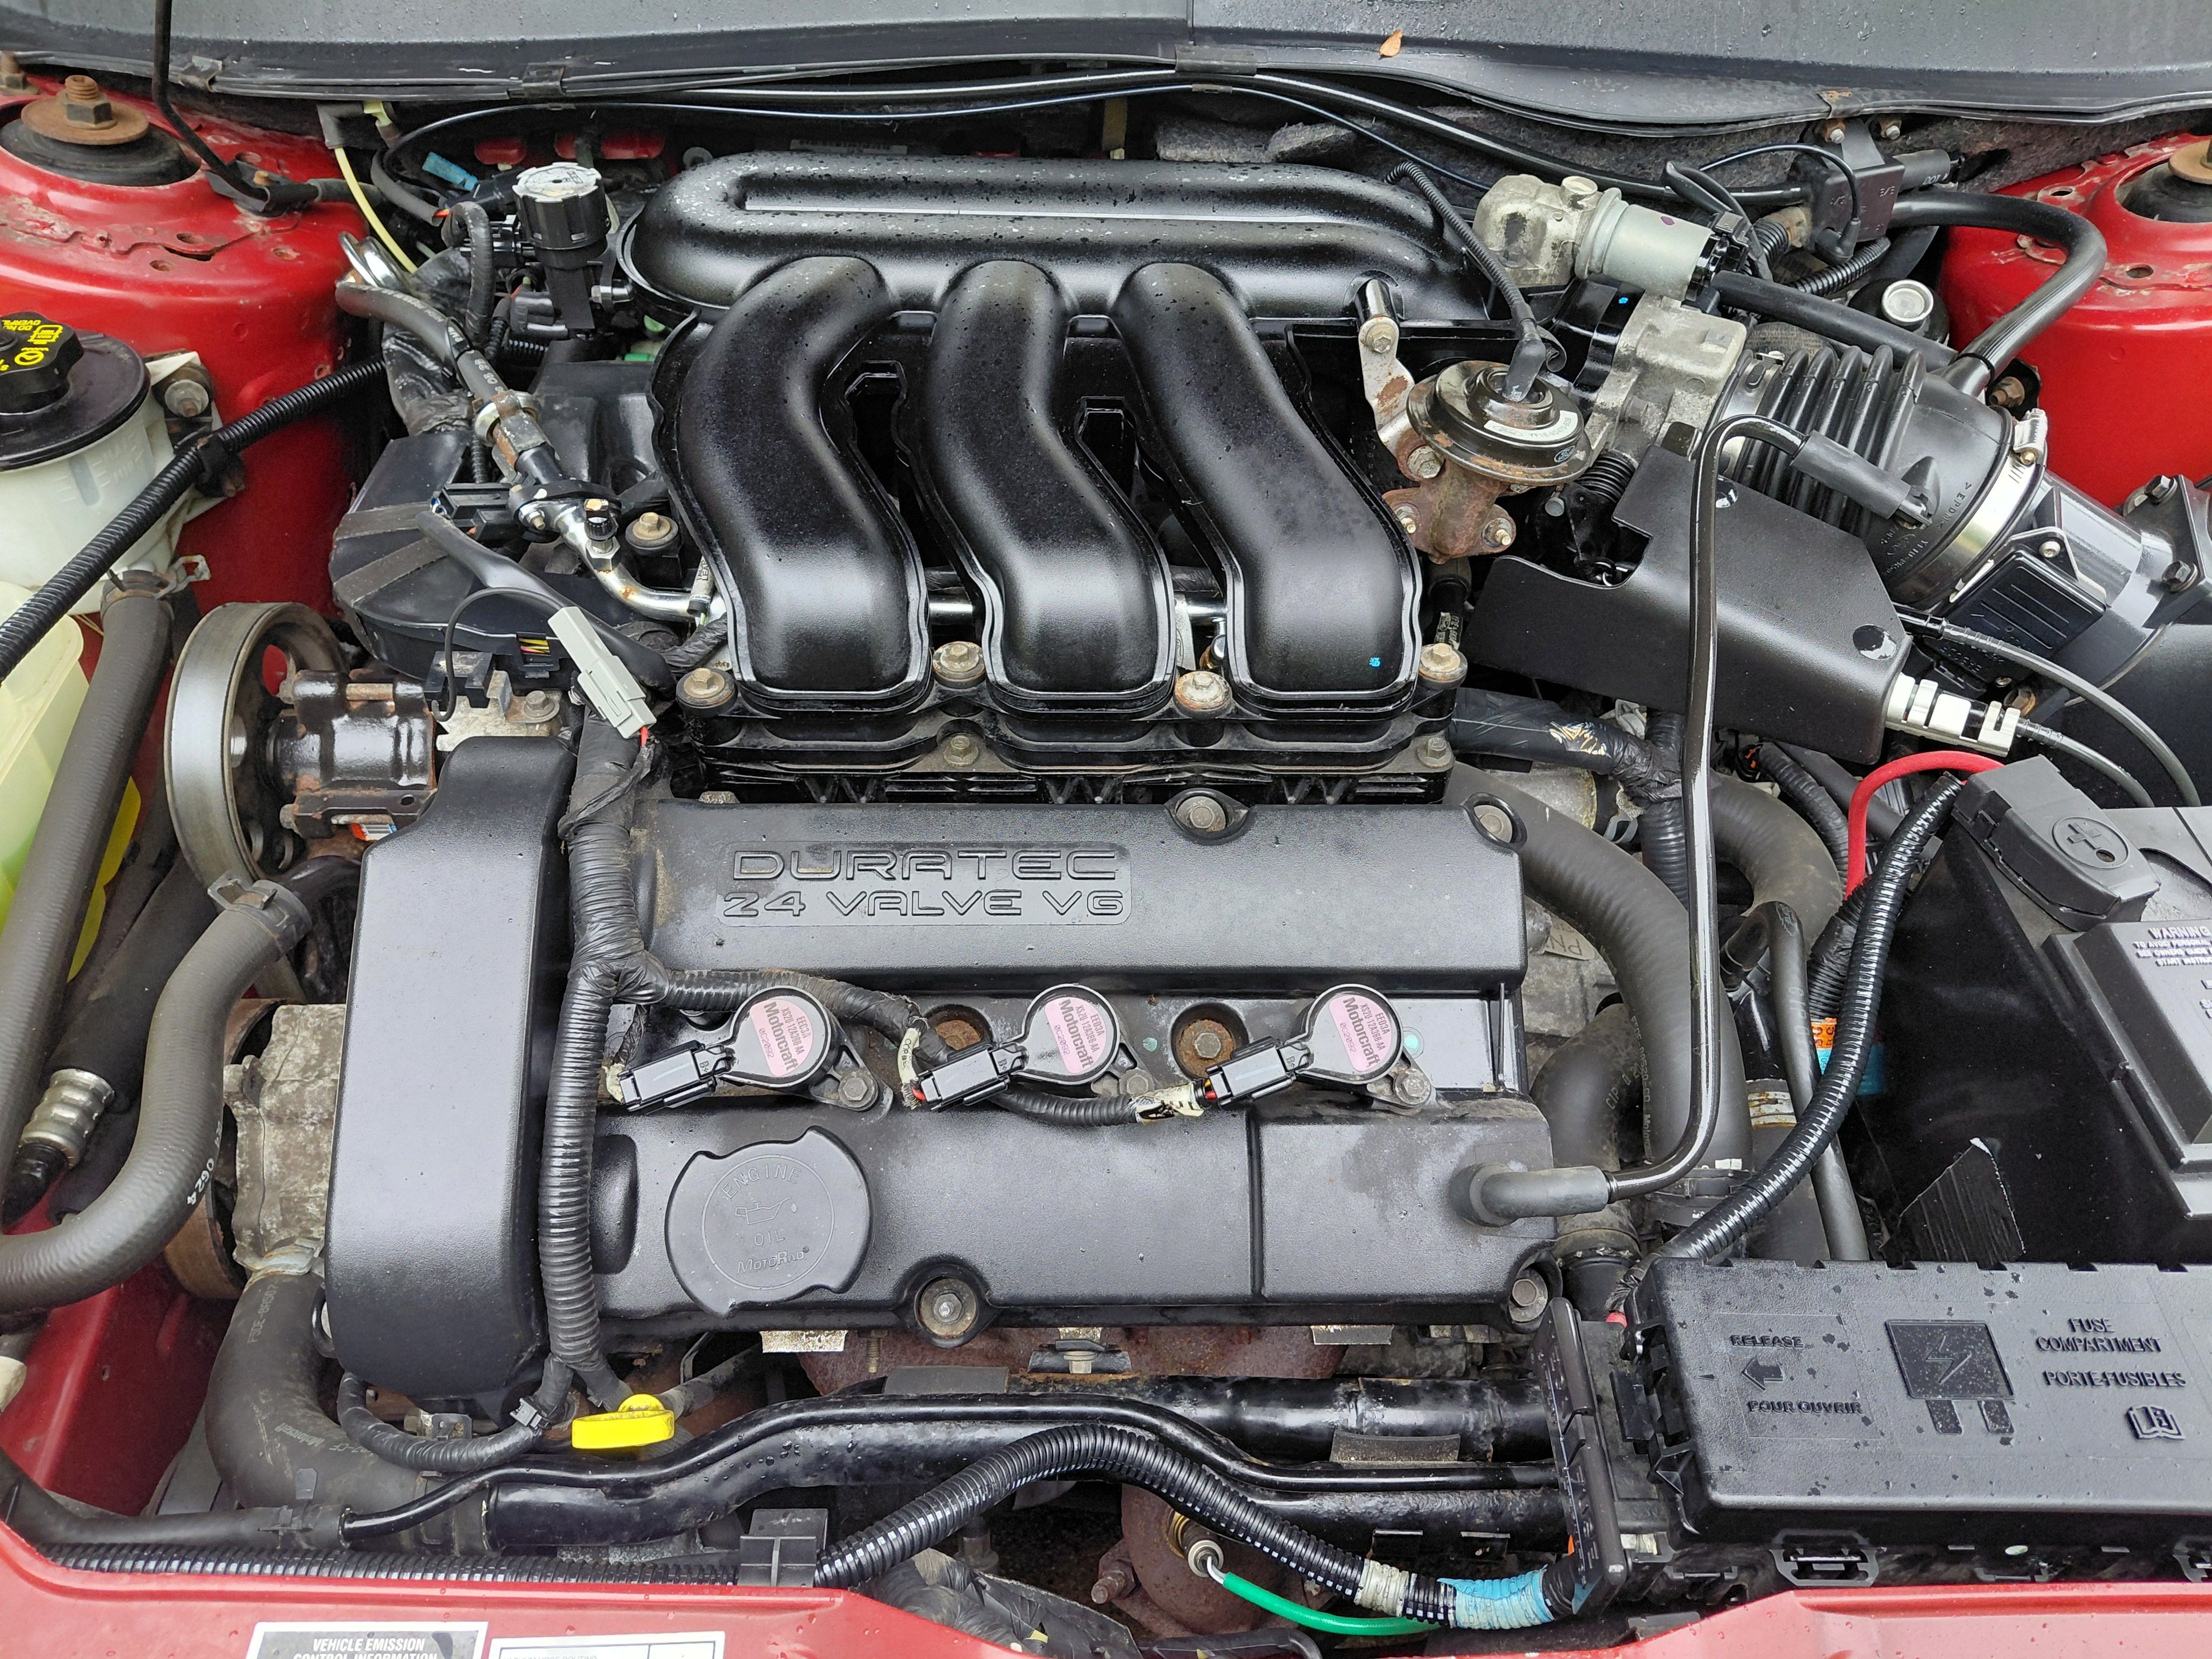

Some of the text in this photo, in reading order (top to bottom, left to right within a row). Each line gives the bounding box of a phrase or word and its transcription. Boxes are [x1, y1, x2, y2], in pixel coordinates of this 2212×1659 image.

[733, 850, 1116, 880] DURATEC
[723, 890, 1124, 917] 24 VALVE V6
[2147, 925, 2211, 940] WARNING
[2132, 941, 2146, 949] TO
[2170, 939, 2210, 948] PERSONAL
[764, 1001, 799, 1071] Motorcraft
[1059, 999, 1094, 1068] Motorcraft
[1343, 997, 1380, 1068] Motorcraft
[722, 1164, 802, 1200] ENGINE
[754, 1230, 785, 1245] OIL
[2068, 1318, 2114, 1333] FUSE
[1730, 1335, 1804, 1348] RELEASE
[2036, 1336, 2162, 1352] COMPARTMENT
[2042, 1371, 2186, 1387] PORTE-FUSIBLES
[1747, 1400, 1863, 1414] POUR OUVRIR
[274, 1423, 325, 1447] Motorcraft
[313, 1638, 425, 1651] VEHICLE EMISSION
